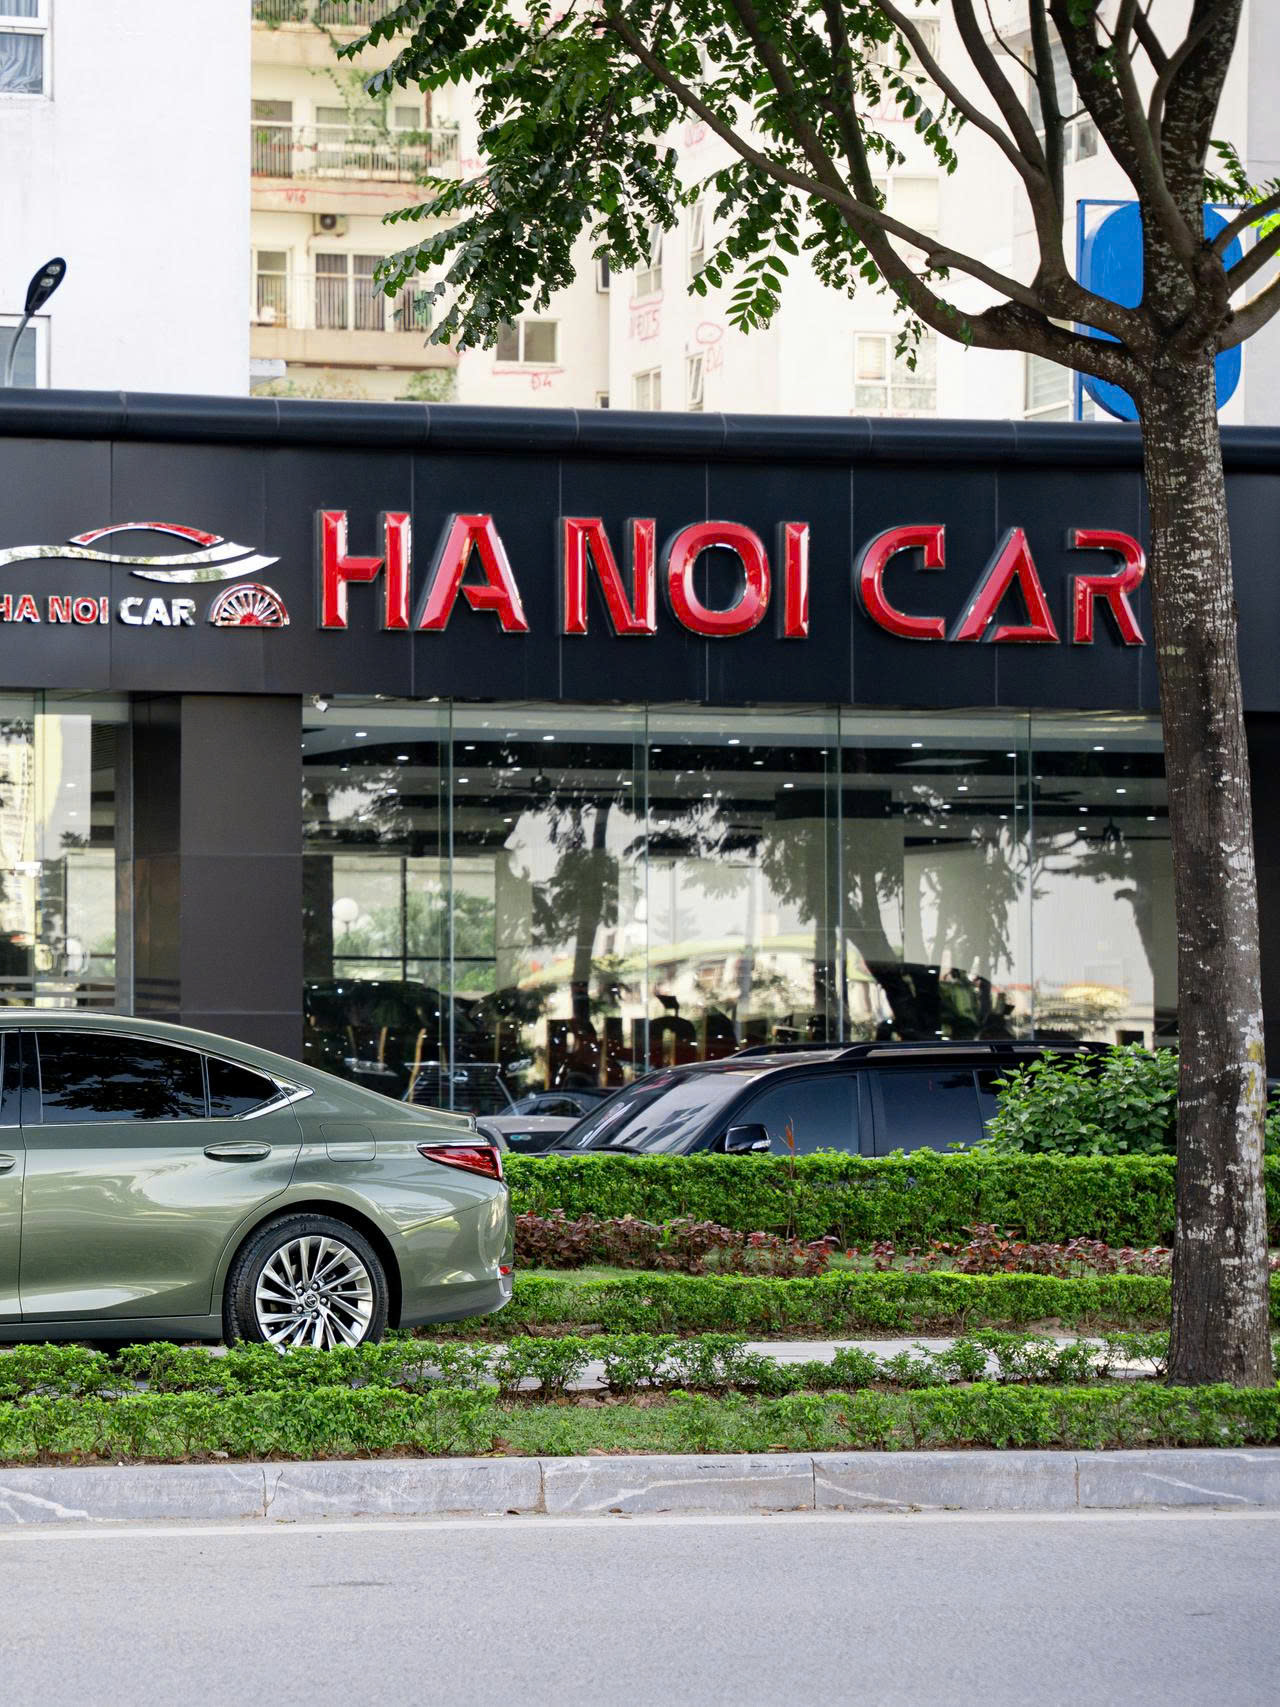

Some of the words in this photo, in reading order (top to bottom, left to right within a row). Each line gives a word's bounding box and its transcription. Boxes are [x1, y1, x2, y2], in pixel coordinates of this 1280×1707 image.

[48, 595, 109, 625] NOI
[119, 596, 197, 627] CAR
[317, 509, 530, 632] HA
[562, 516, 811, 639] NOI
[857, 524, 1147, 647] CAR
